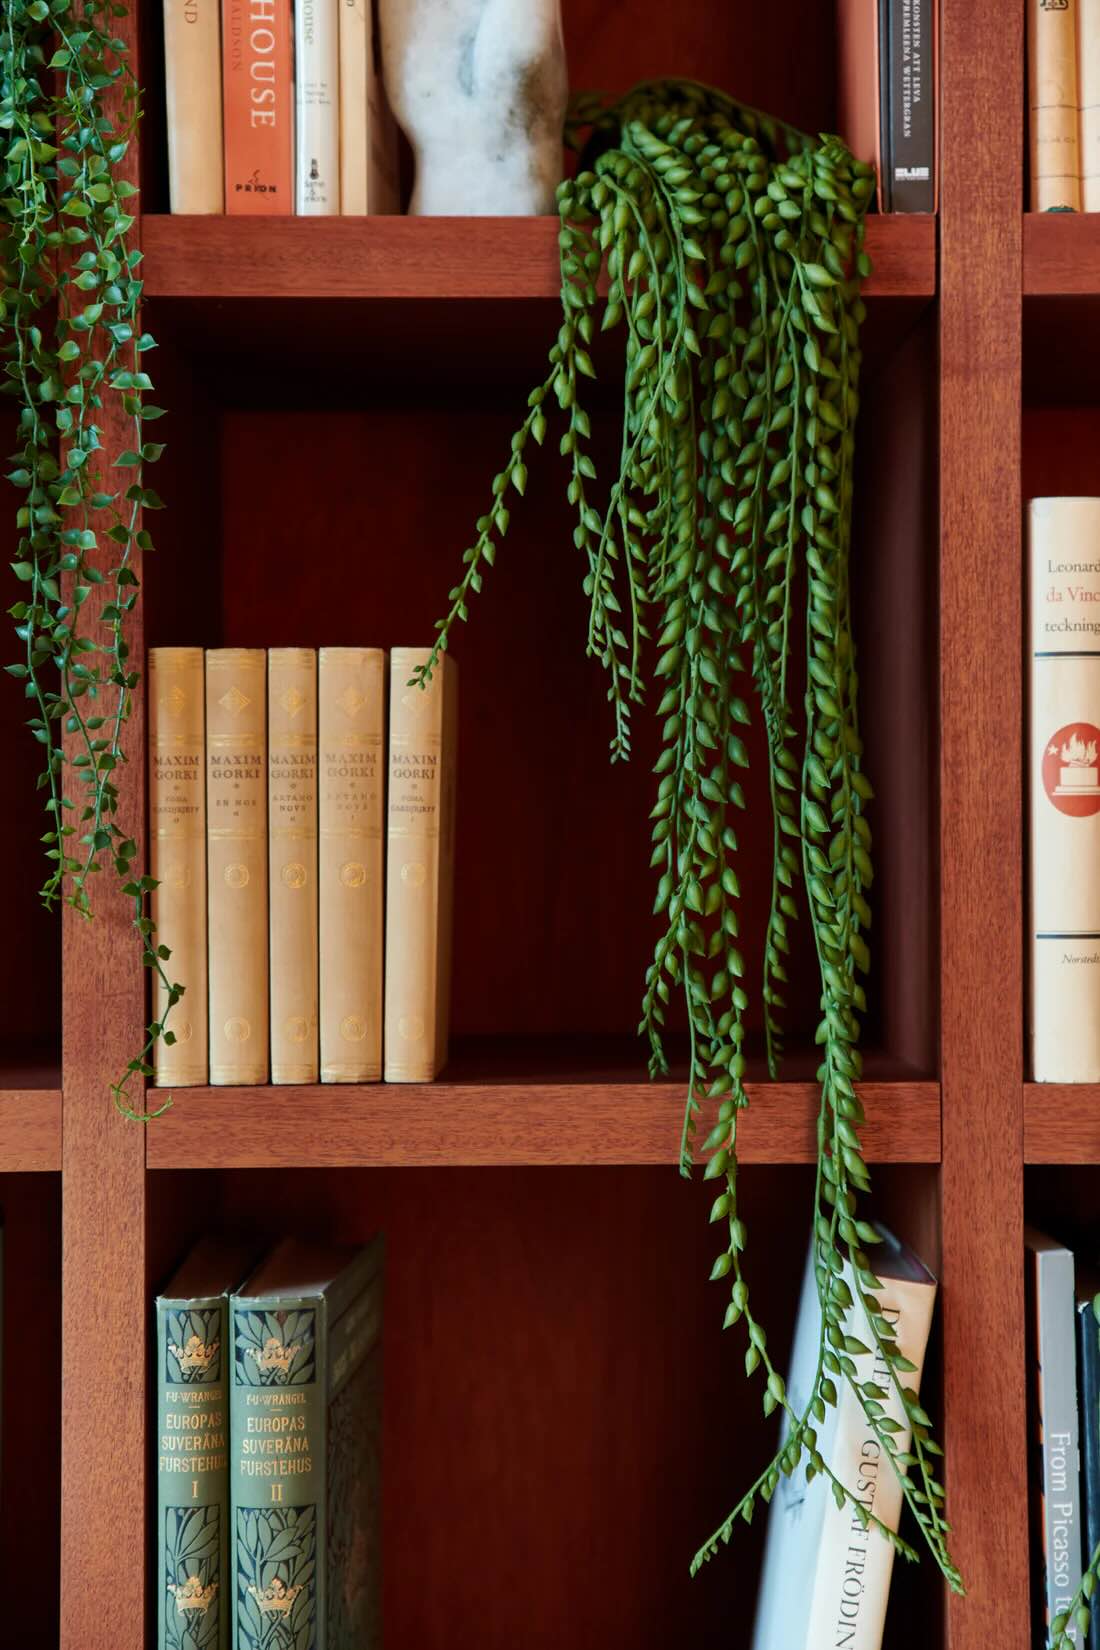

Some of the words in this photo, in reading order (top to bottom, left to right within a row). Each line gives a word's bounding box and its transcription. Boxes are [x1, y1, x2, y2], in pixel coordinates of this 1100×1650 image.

[913, 0, 921, 48] KONSTEN
[250, 0, 276, 128] HOUSE
[913, 52, 921, 72] ATT
[913, 77, 921, 103] LEVA
[903, 66, 911, 138] WETTERGRAN
[1046, 586, 1064, 602] da
[210, 755, 262, 765] MAXIM
[270, 754, 315, 765] MAXIM
[325, 752, 377, 764] MAXIM
[392, 754, 437, 765] MAXIM
[212, 768, 260, 779] GORKI
[271, 768, 313, 779] GORKI
[327, 767, 375, 777] GORKI
[393, 768, 436, 780] GORKI
[166, 1411, 222, 1430] EUROPAS
[246, 1415, 306, 1433] EUROPAS
[161, 1433, 225, 1451] SUVERÄNA
[242, 1436, 310, 1454] SUVERÄNA
[240, 1457, 313, 1477] FURSTEHUS
[1050, 1431, 1072, 1493] From
[191, 1480, 199, 1498] I
[271, 1483, 284, 1502] II
[1053, 1502, 1074, 1588] Picasso
